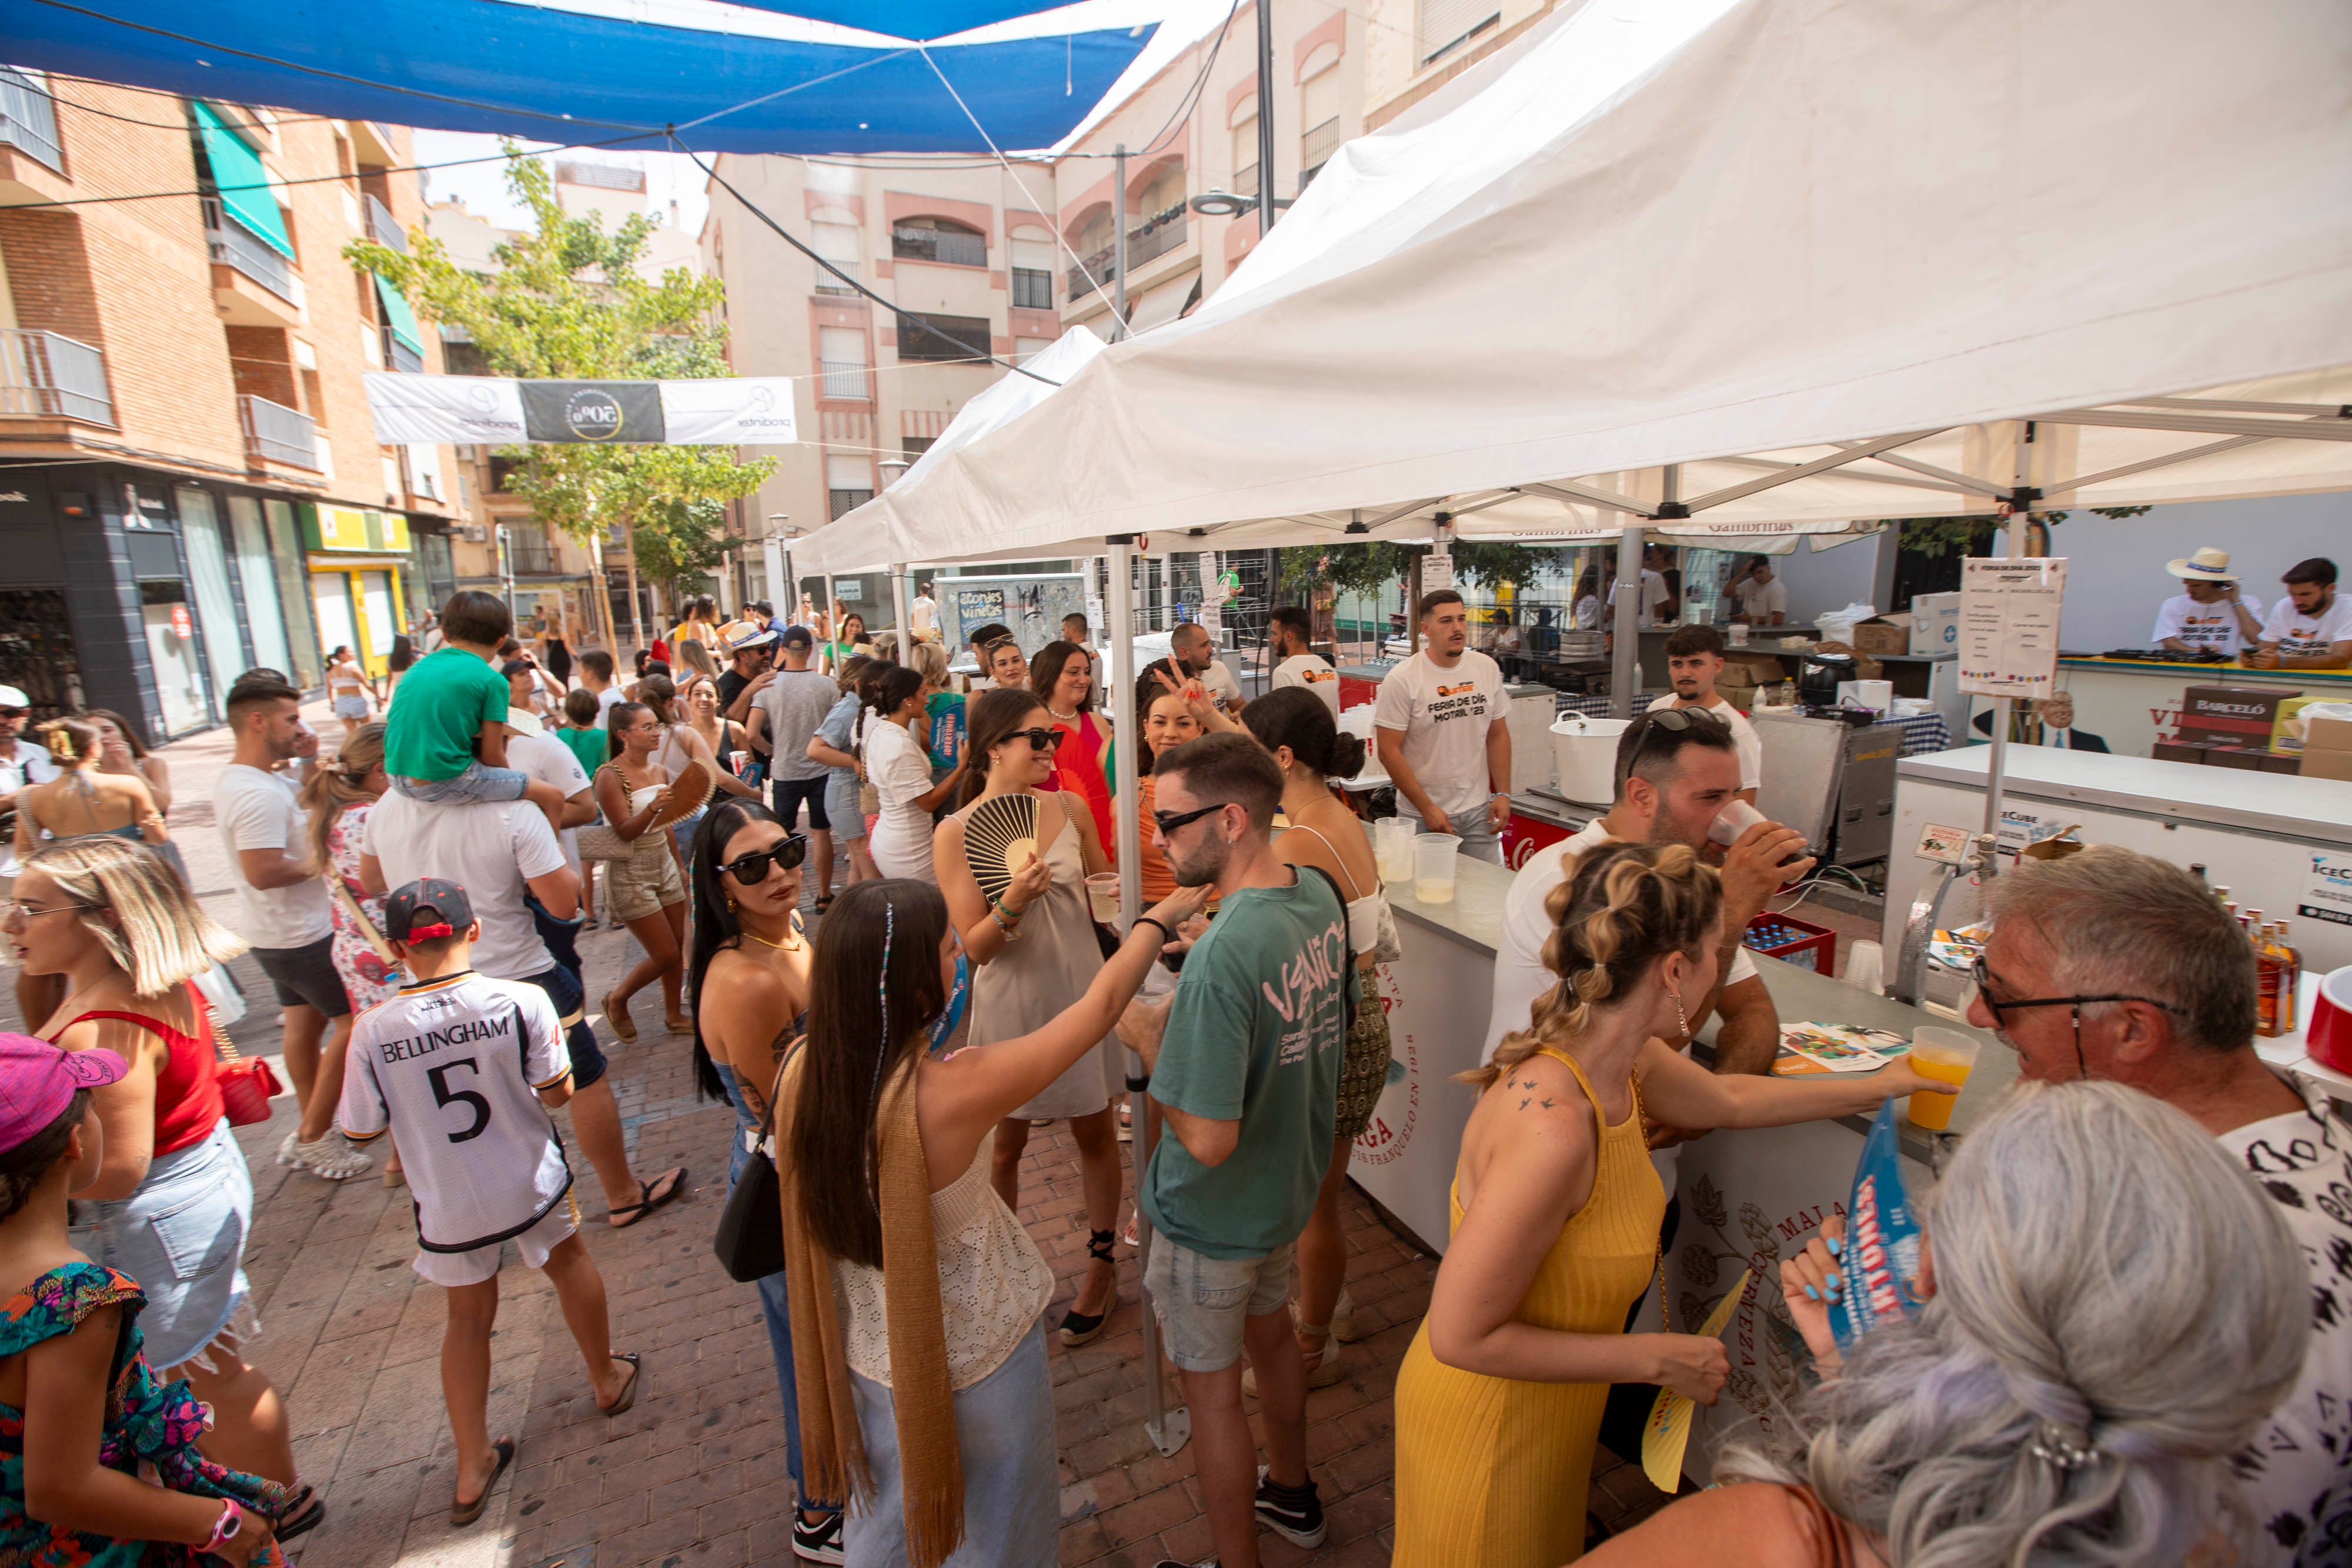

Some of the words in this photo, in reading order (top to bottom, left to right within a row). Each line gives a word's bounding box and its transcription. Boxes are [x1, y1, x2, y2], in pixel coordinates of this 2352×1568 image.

[1428, 699, 1455, 713] FERIA
[1457, 696, 1470, 706] DE
[1472, 693, 1487, 704] DÍA
[1434, 708, 1468, 723] MOTRIL
[944, 713, 956, 756] ¡OFERTONES!
[380, 1017, 509, 1064] BELLINGHAM
[426, 1057, 492, 1144] 5
[1738, 1251, 1768, 1366] CERVEZA
